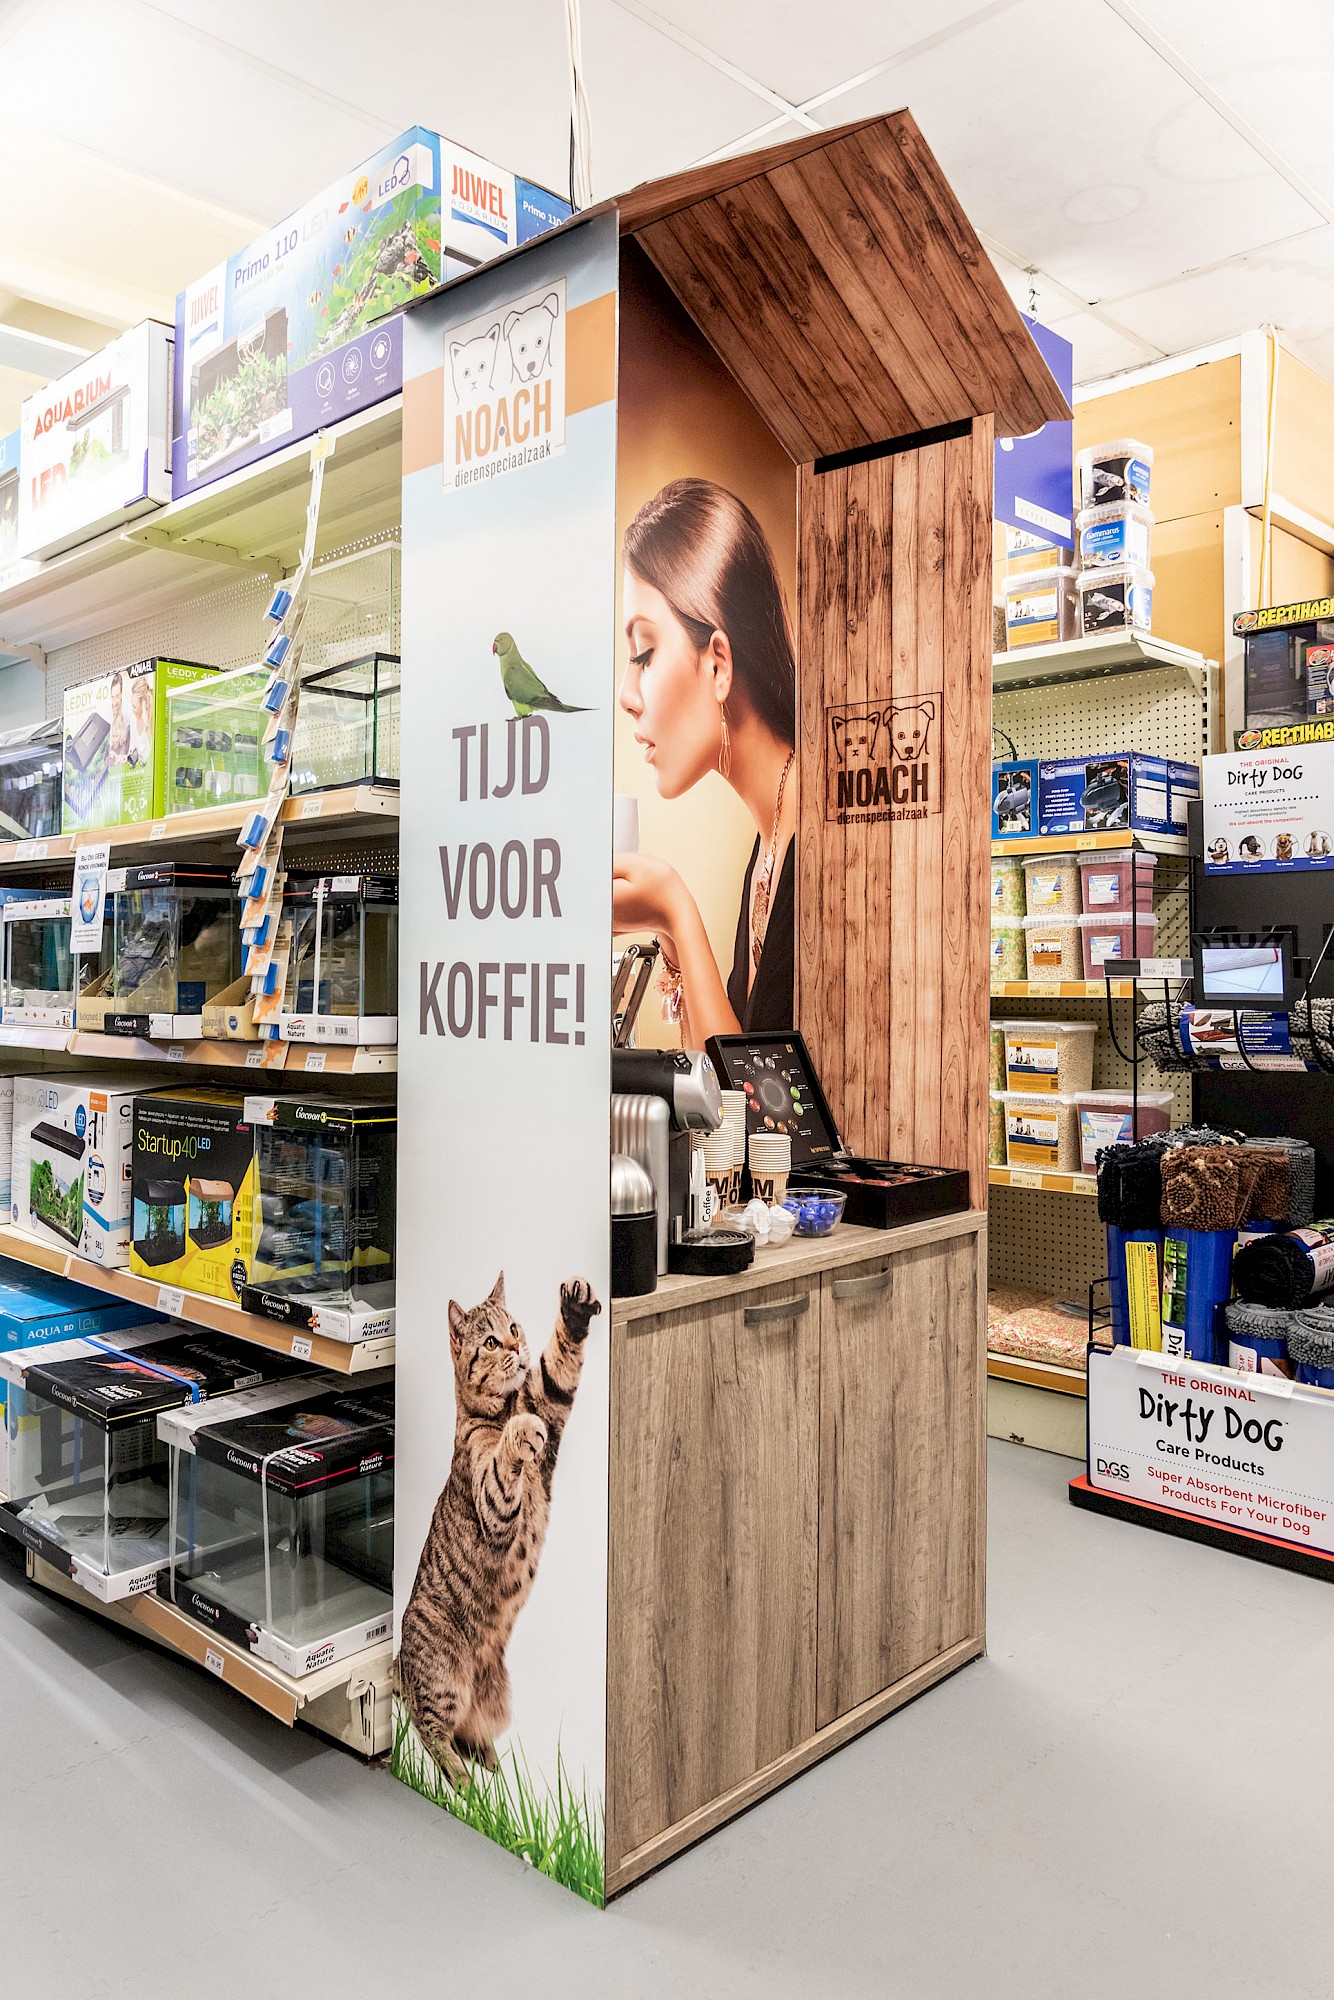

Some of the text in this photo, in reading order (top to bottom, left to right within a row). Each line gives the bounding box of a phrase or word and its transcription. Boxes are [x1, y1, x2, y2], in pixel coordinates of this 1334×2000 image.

[378, 175, 398, 197] LED
[452, 164, 508, 221] JUWEL
[451, 198, 509, 230] AQUARIUM
[523, 200, 546, 220] Primo
[234, 254, 270, 289] Primo
[274, 229, 298, 261] 110
[190, 284, 219, 328] JUWEL
[33, 370, 112, 441] AQUARIUM
[455, 379, 552, 466] NOACH
[455, 439, 552, 488] dierenspeciaalzaak
[32, 463, 66, 514] LED
[1086, 526, 1119, 540] Gammarus
[167, 666, 198, 678] LEDDY
[65, 685, 109, 712] LEDDY 40
[452, 714, 551, 802] TIJD
[1254, 758, 1290, 767] ORIGINAL
[837, 762, 929, 809] NOACH
[1227, 768, 1268, 789] Dirty
[837, 806, 929, 825] dierenspeciaalzaak
[137, 871, 154, 881] Cocoon
[438, 837, 563, 920] VOOR
[419, 961, 586, 1046] KOFFIE!
[114, 1016, 137, 1028] Cocoon 2
[286, 1023, 306, 1031] Aquatic
[287, 1030, 306, 1038] Nature
[75, 1112, 86, 1127] LED
[295, 1106, 327, 1123] Cocoon 3
[702, 1190, 712, 1223] Coffee
[1149, 1268, 1158, 1296] WERKT
[261, 1294, 285, 1311] Cocoon
[1151, 1295, 1159, 1313] HET?
[28, 1326, 60, 1339] AQUA
[63, 1324, 74, 1332] 80
[362, 1319, 391, 1331] Aquatic
[362, 1327, 389, 1337] Nature
[52, 1384, 72, 1403] Cocoon
[1161, 1373, 1256, 1402] THE ORIGINAL
[1138, 1388, 1214, 1443] Dirty
[227, 1450, 258, 1473] Cocoon 6
[359, 1454, 384, 1467] Aquatic
[359, 1462, 383, 1473] Nature
[1156, 1440, 1265, 1477] Care Products
[1147, 1466, 1183, 1486] Super
[1186, 1476, 1254, 1503] Absorbent
[1257, 1494, 1327, 1522] Microfiber
[1162, 1485, 1311, 1536] Products For Your Dog
[23, 1527, 39, 1545] Cocoon
[129, 1572, 157, 1586] Aquatic
[129, 1579, 156, 1592] Nature
[192, 1593, 214, 1615] Cocoon
[305, 1646, 335, 1663] Aquatic
[305, 1654, 334, 1671] Nature
